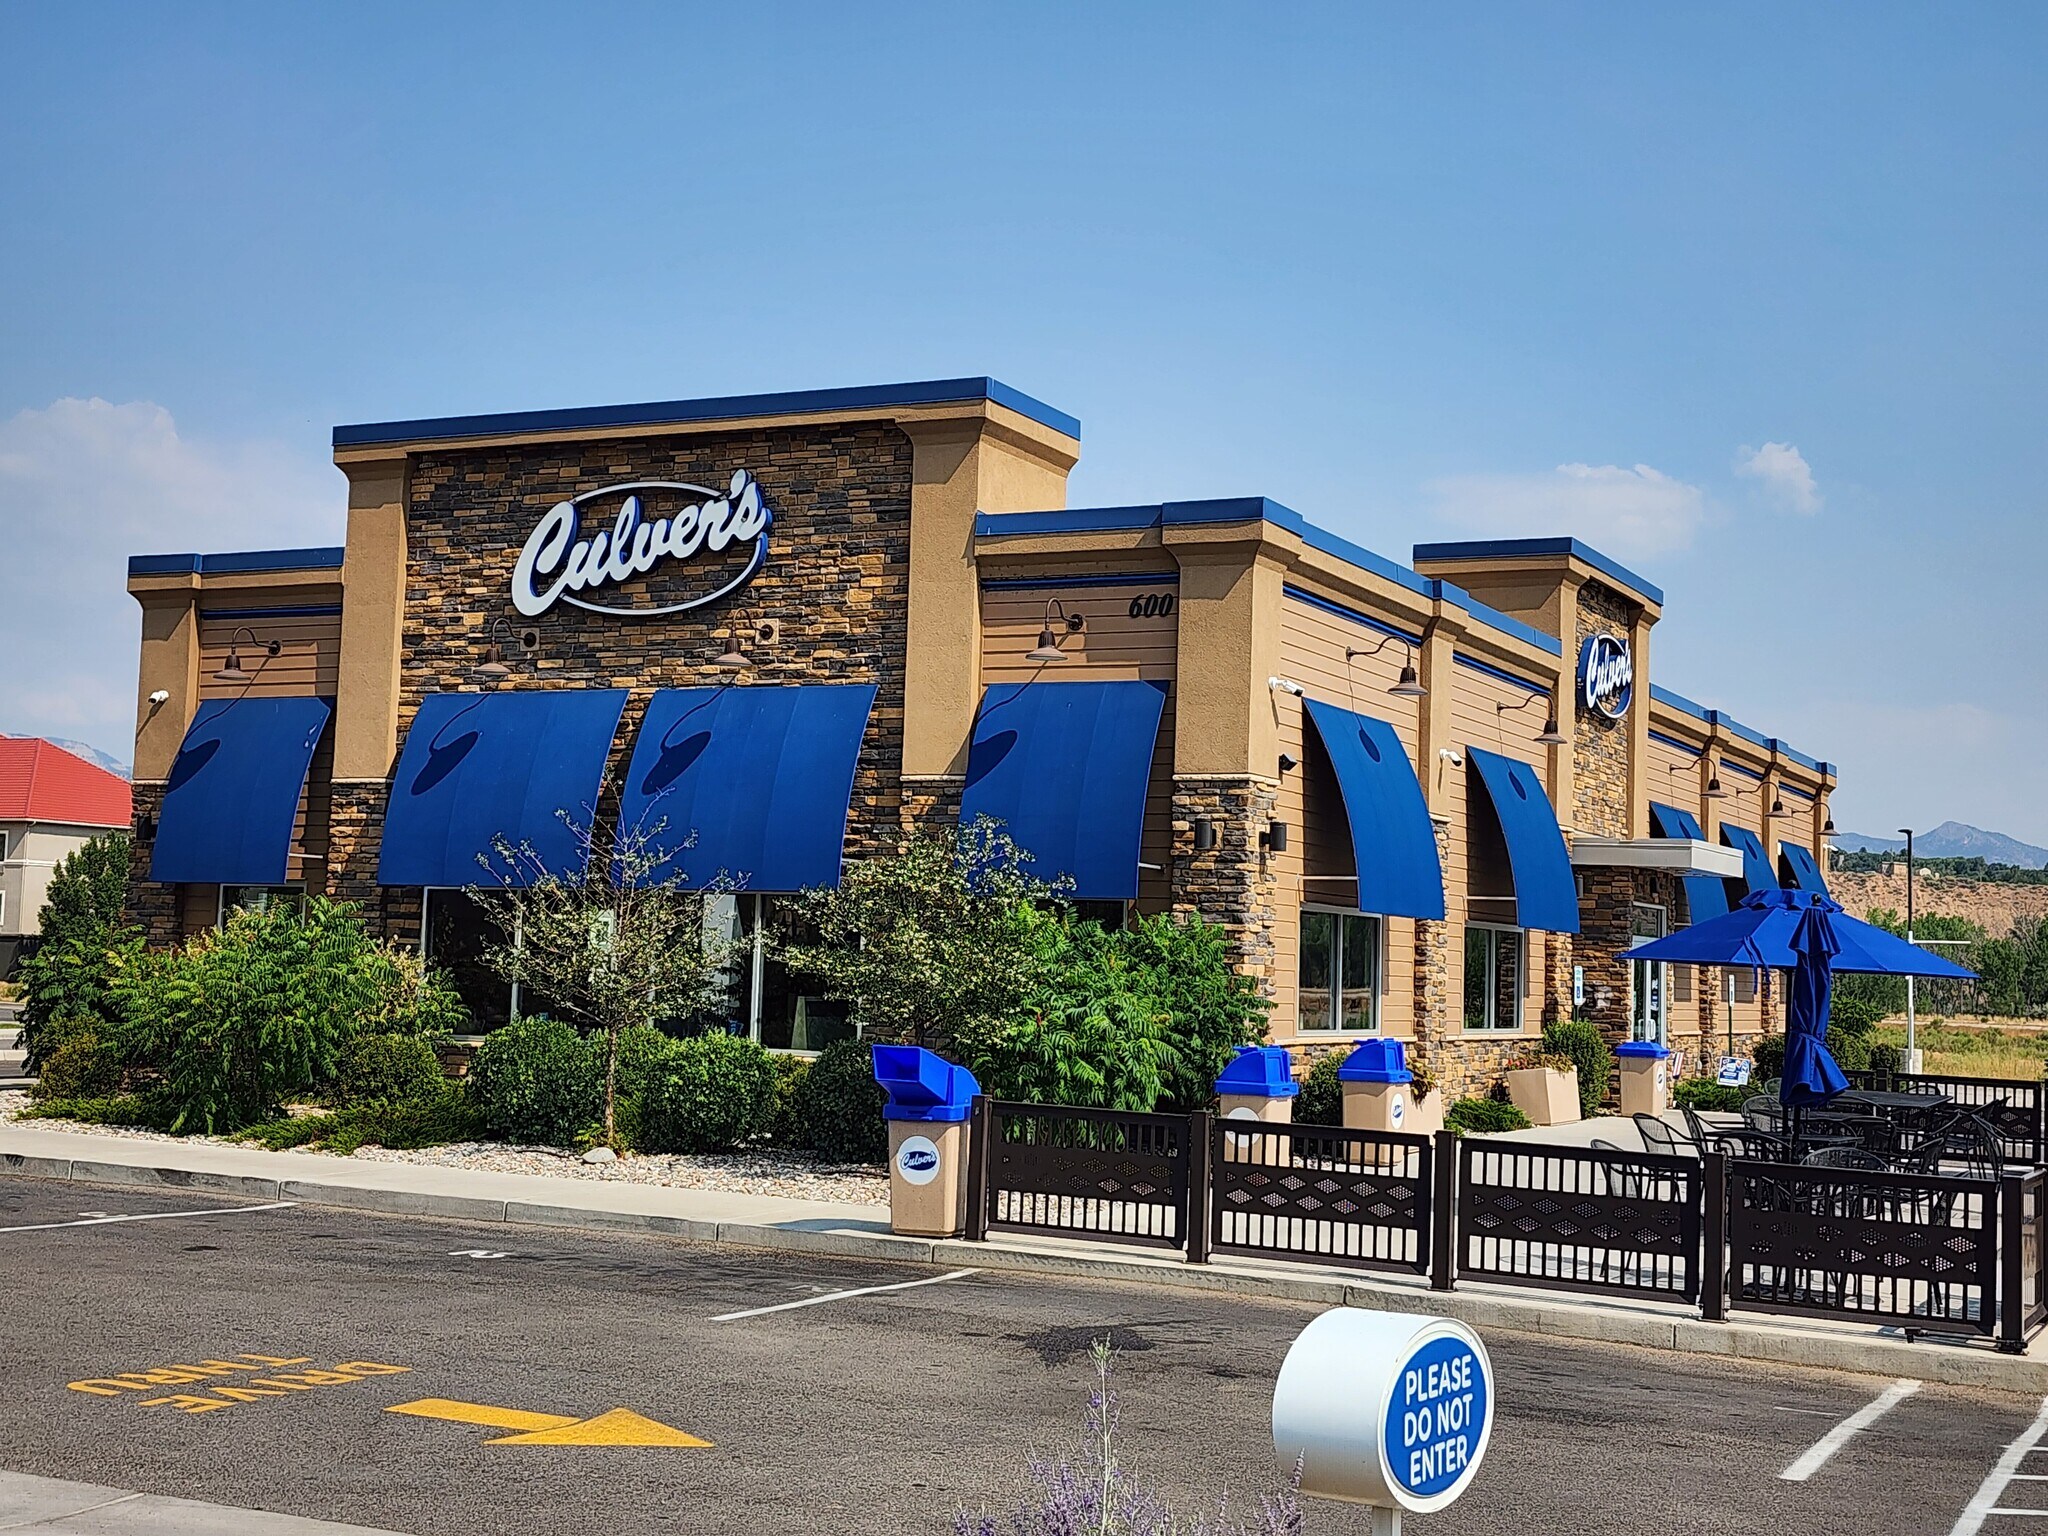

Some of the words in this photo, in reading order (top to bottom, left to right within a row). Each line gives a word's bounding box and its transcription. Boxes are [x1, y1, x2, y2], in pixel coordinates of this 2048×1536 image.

[512, 468, 769, 616] Culver's
[1129, 593, 1173, 618] 600
[1586, 636, 1633, 709] Culver's
[901, 1150, 938, 1170] Culver's
[66, 1353, 313, 1396] THRU
[137, 1361, 413, 1414] DRIVE
[1405, 1353, 1472, 1406] PLEASE
[1404, 1407, 1432, 1447] DO
[1437, 1393, 1473, 1437] NOT
[1410, 1434, 1468, 1487] ENTER
